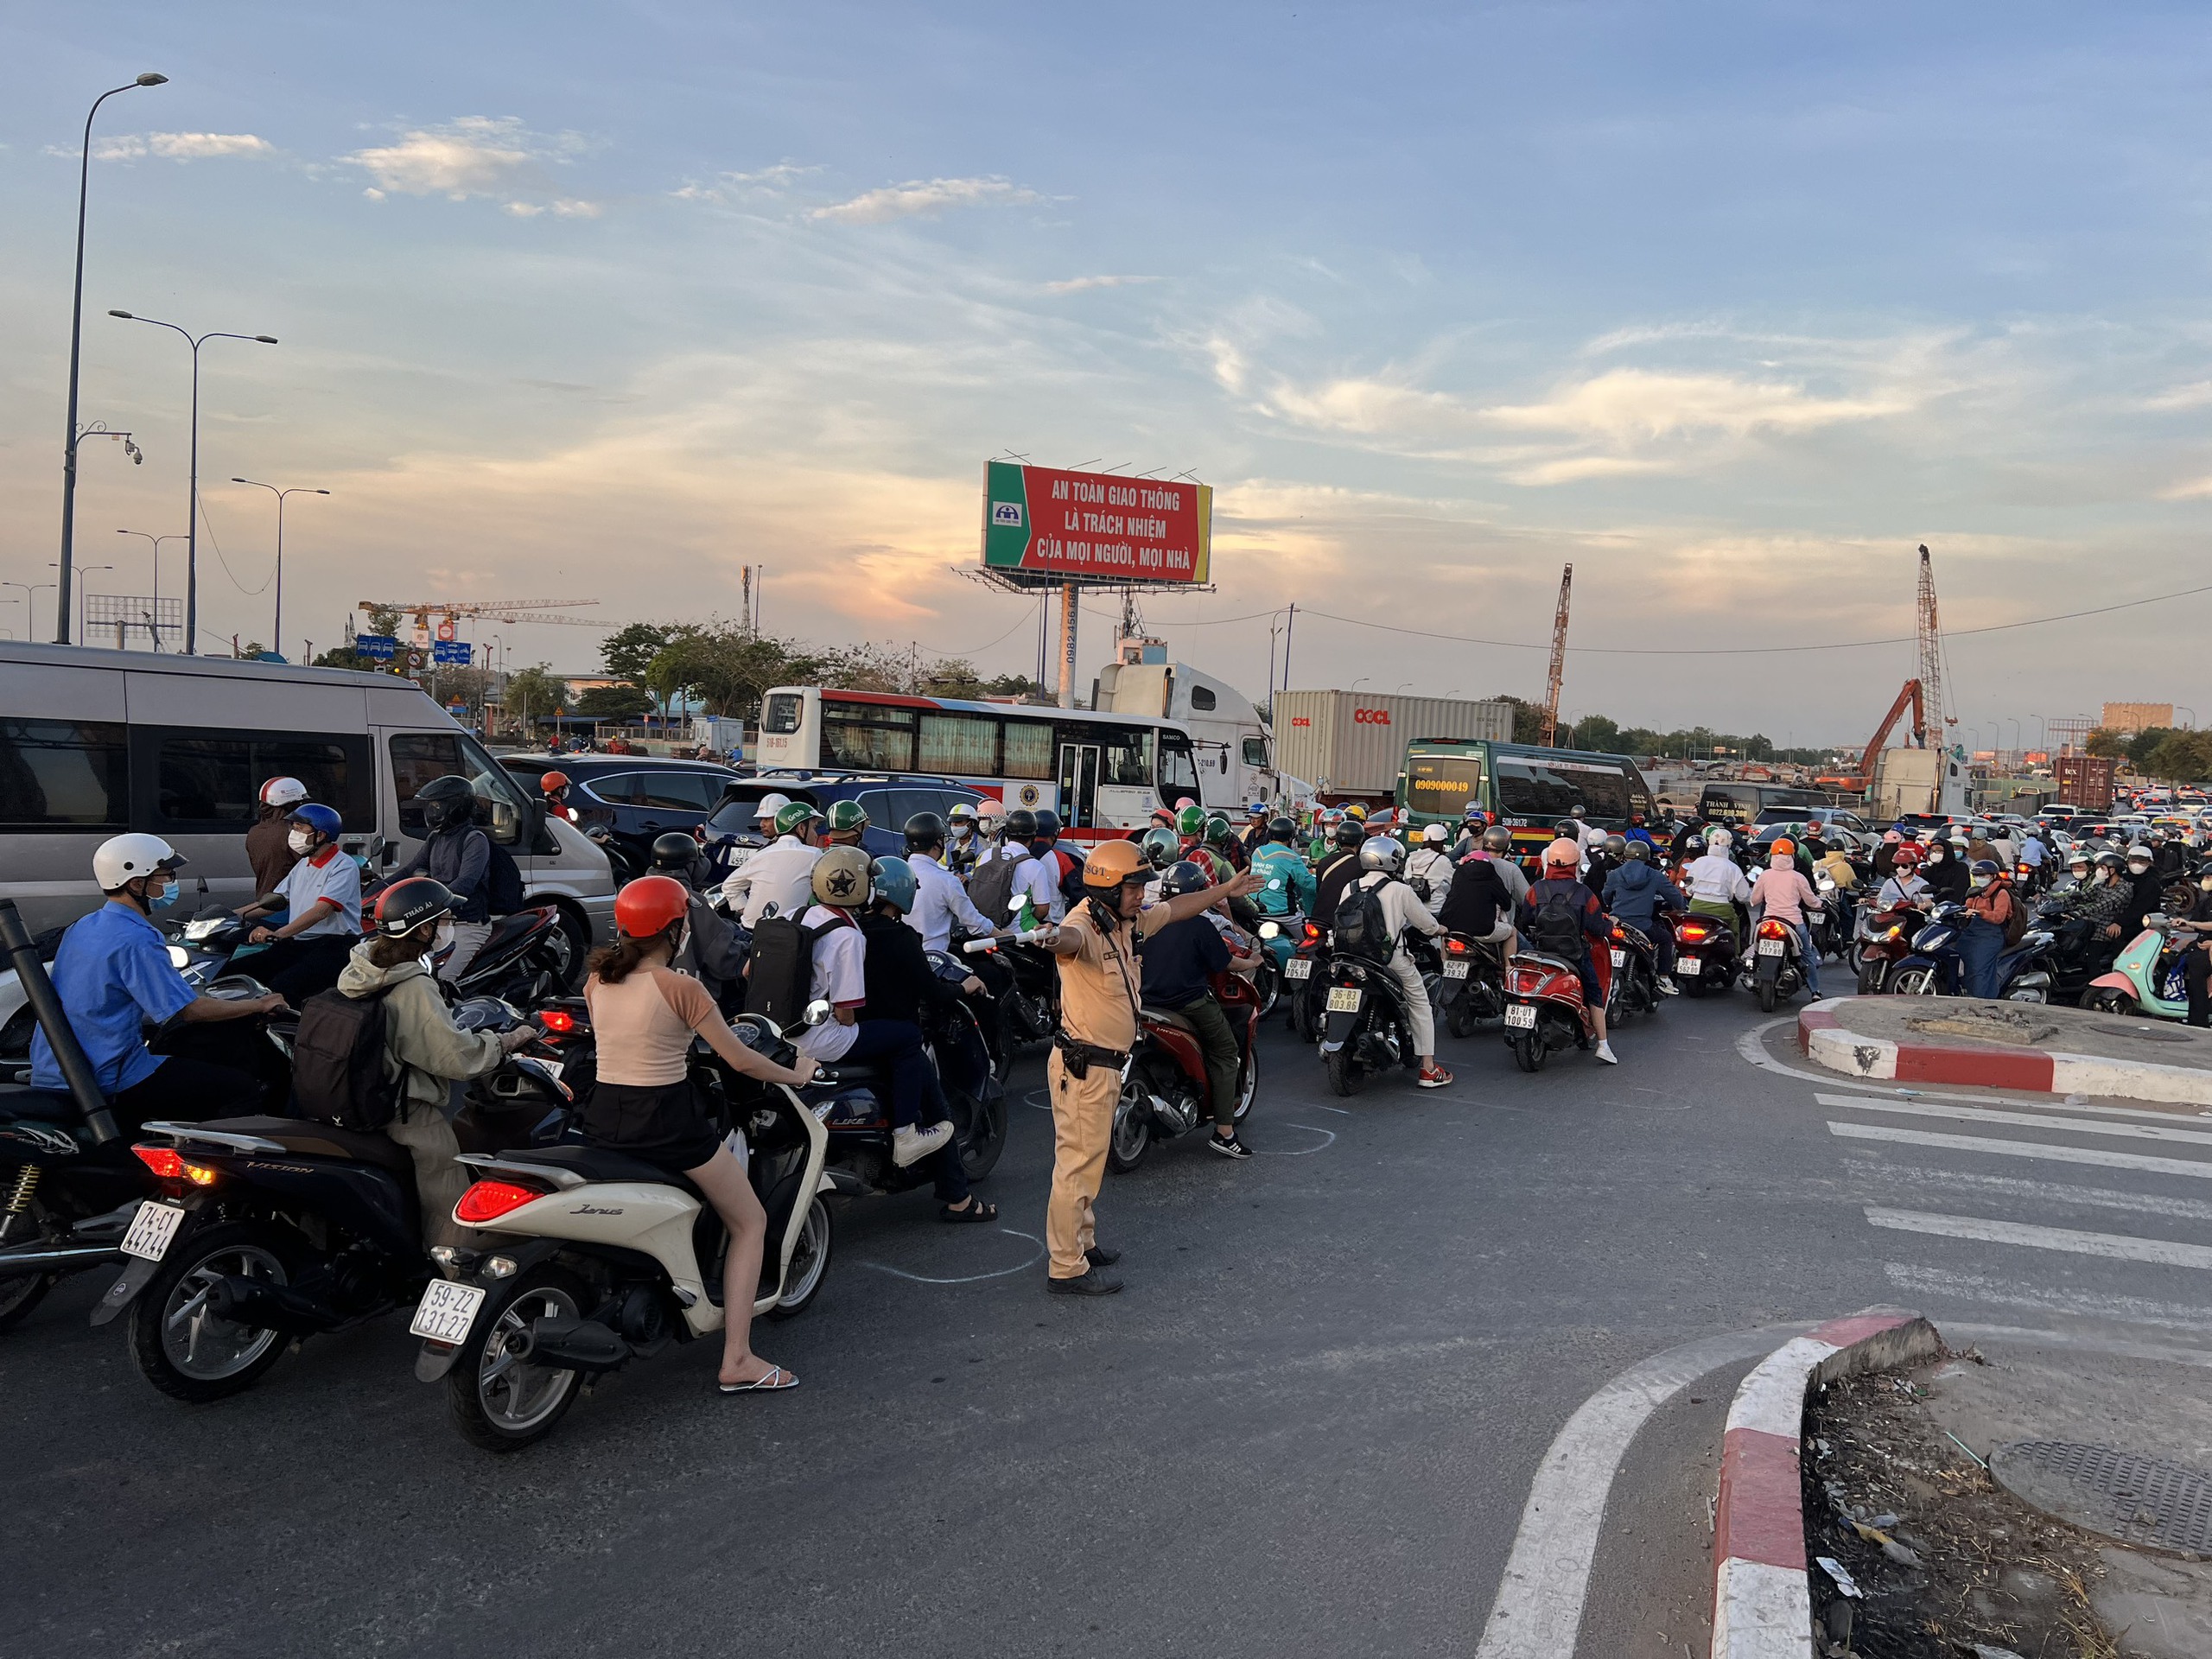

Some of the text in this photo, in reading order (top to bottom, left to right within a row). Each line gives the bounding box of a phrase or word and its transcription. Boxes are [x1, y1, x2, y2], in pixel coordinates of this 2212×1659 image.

[1052, 479, 1180, 512] AN TOÀN GIAO THÔNG
[1065, 506, 1166, 542] LÀ TRÁCH NHIỆM
[1037, 532, 1191, 572] CỦA MỌI NGƯỜI, MỌI NHÀ
[1066, 586, 1077, 664] 0982 456 686
[1291, 717, 1311, 728] OOCL
[1354, 709, 1391, 726] OOCL
[1415, 779, 1469, 792] 0909000049
[1706, 800, 1729, 809] THÀNH
[787, 809, 805, 822] Grab
[849, 811, 864, 822] Grab
[1194, 813, 1205, 825] Grab
[737, 849, 751, 857] 51K
[1445, 961, 1465, 969] 62-P1
[1333, 988, 1357, 1000] 36-B3
[1328, 999, 1357, 1011] 803.86
[1510, 1006, 1532, 1018] 81-U1
[1506, 1015, 1534, 1027] 100.59
[246, 1161, 315, 1174] VISION
[569, 1204, 624, 1216] Janus
[139, 1206, 175, 1233] 74-C1
[126, 1227, 168, 1256] 447.44
[430, 1284, 475, 1314] 59-Z2
[416, 1307, 469, 1339] 131.27
